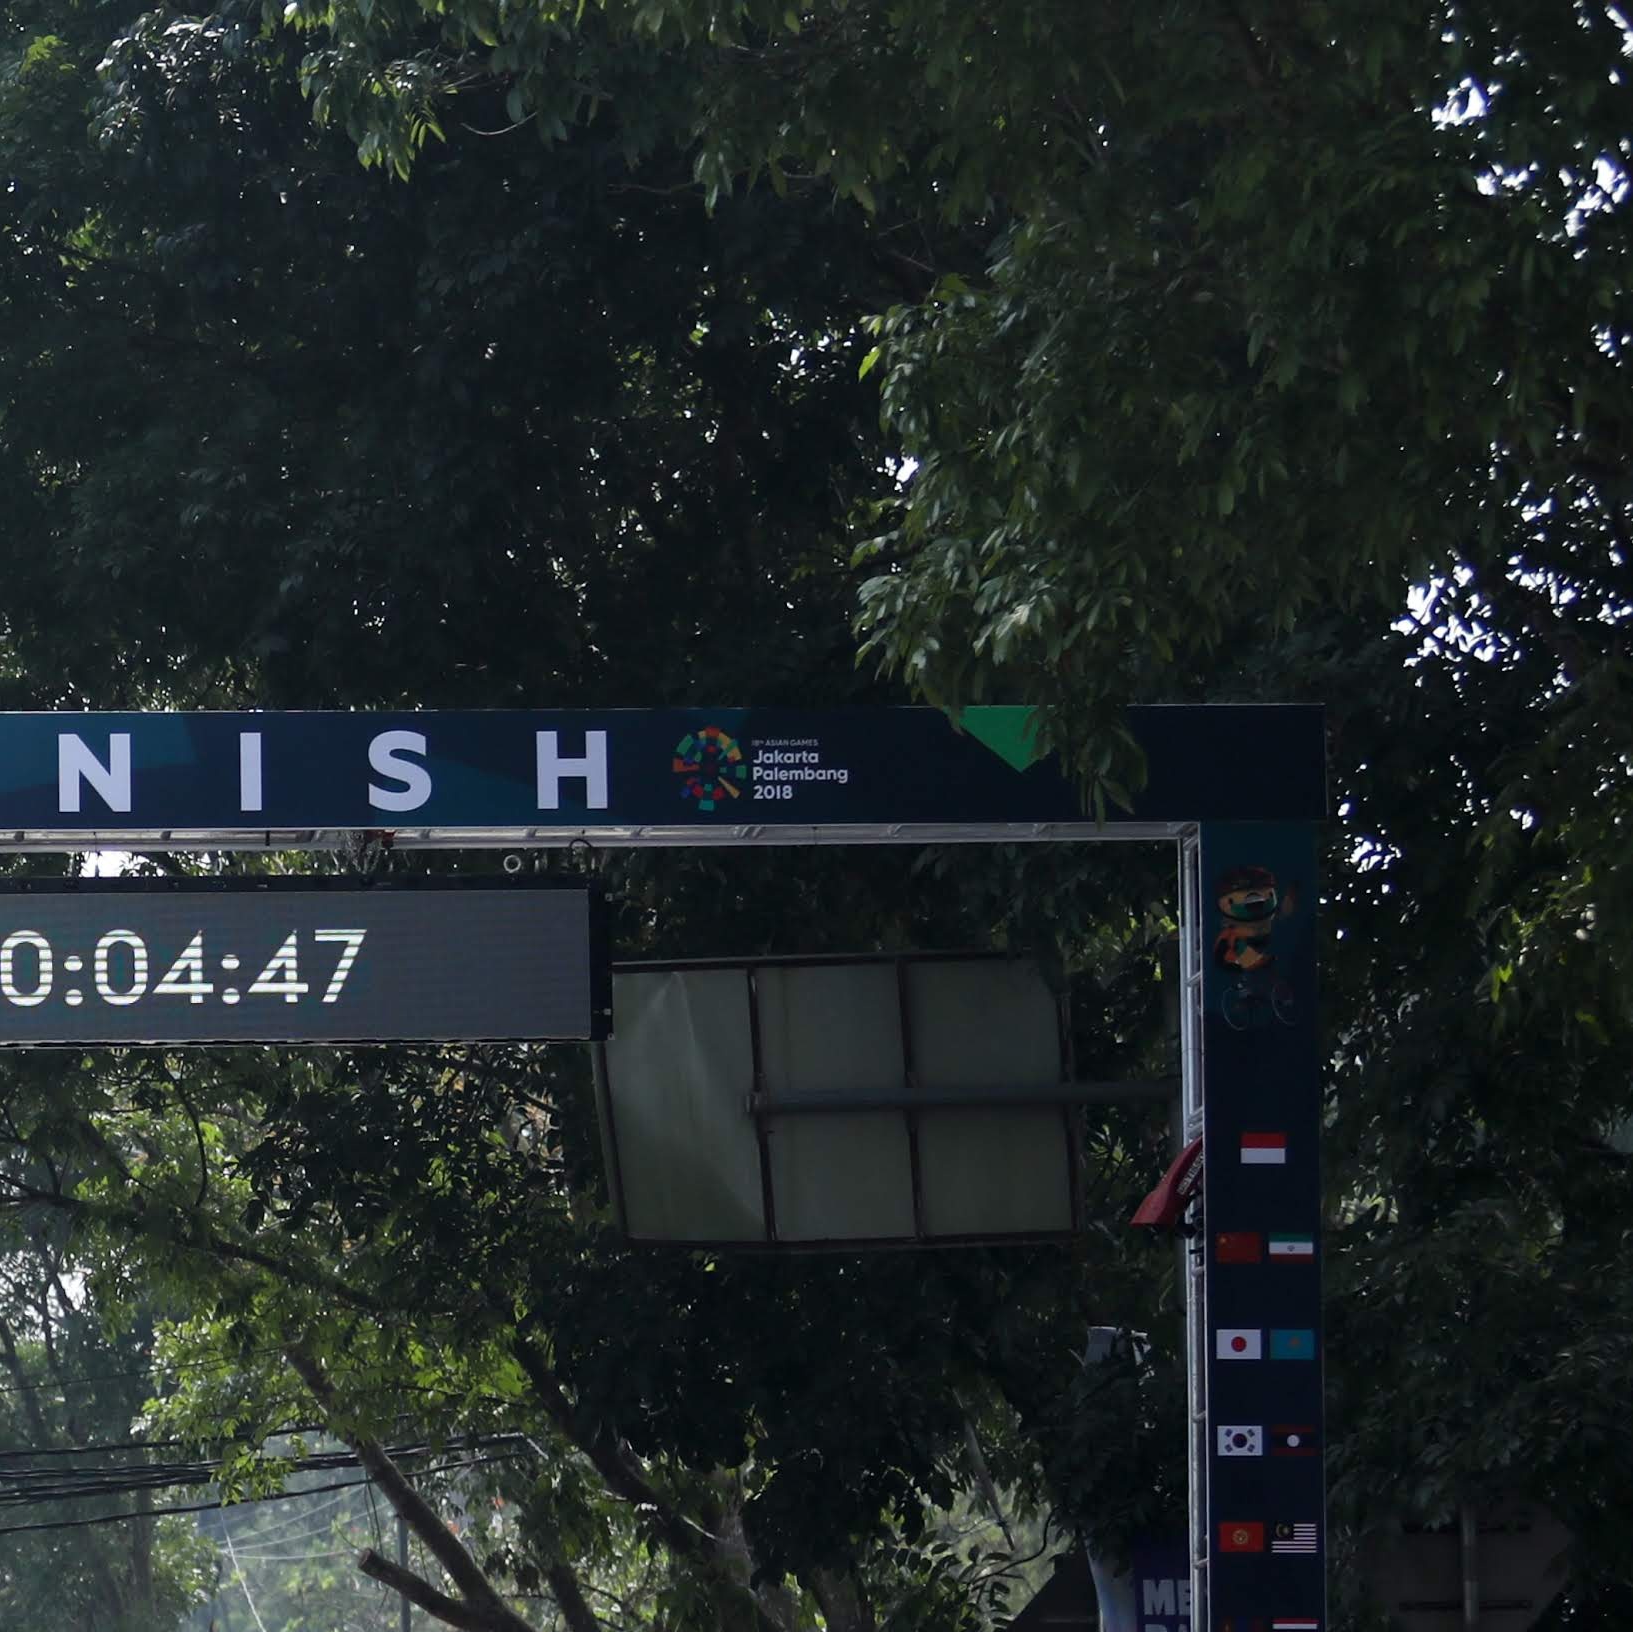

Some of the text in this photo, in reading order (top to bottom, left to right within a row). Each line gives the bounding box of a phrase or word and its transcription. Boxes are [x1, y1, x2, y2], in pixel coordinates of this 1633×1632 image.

[765, 739, 789, 747] ASIAN
[789, 739, 819, 747] GAMES
[753, 749, 819, 764] Jakarta
[752, 766, 848, 784] Palembang
[753, 784, 793, 800] 2018
